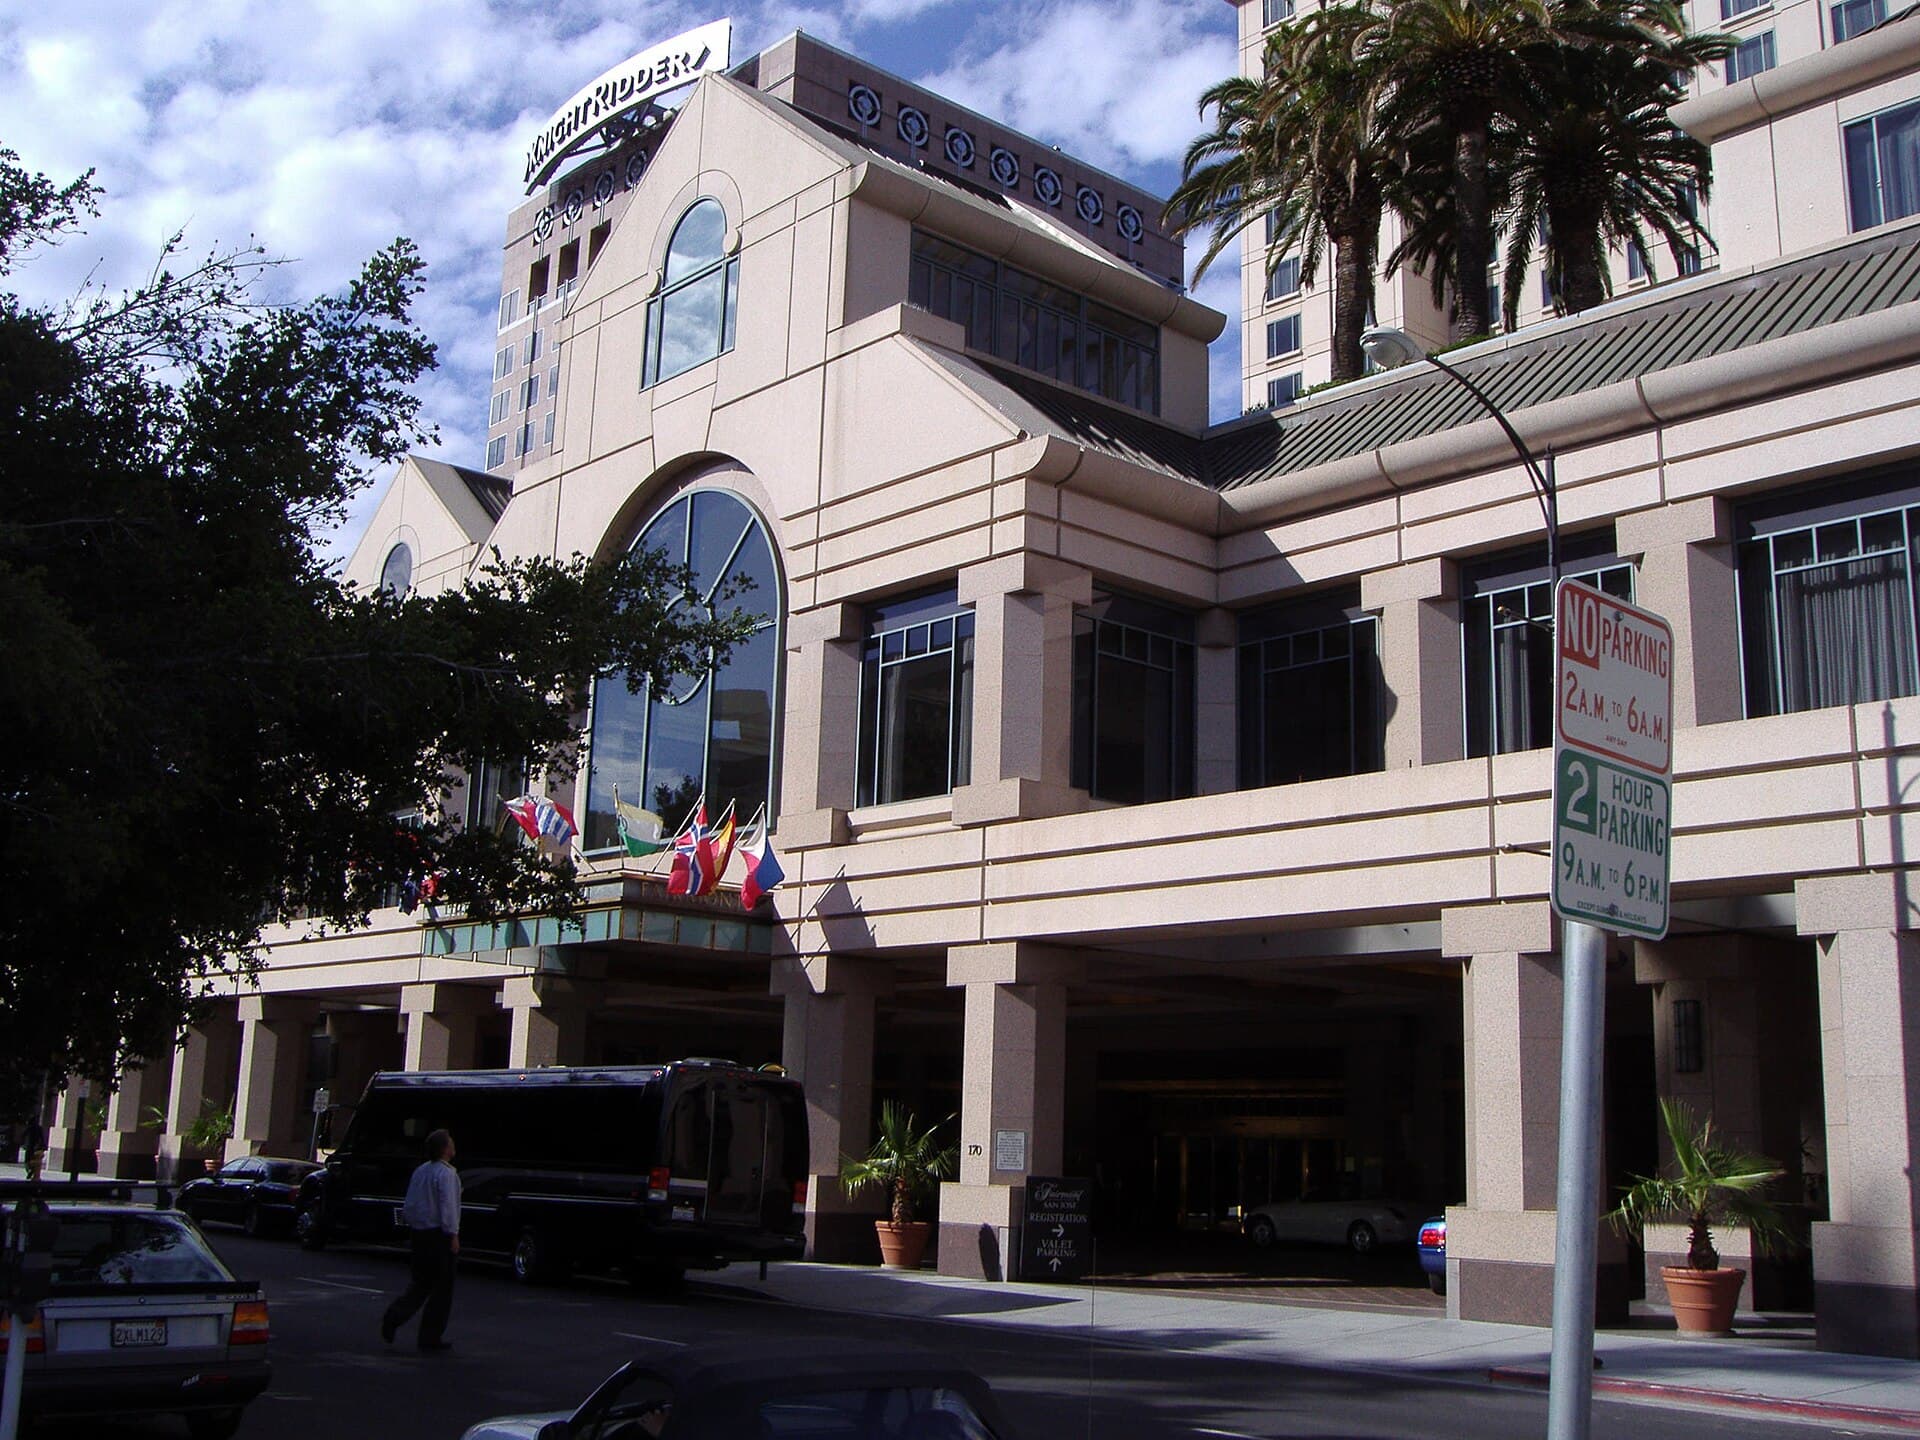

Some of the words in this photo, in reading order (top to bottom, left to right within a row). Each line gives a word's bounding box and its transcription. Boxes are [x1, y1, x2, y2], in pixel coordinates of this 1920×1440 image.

[1564, 590, 1599, 659] NO
[1602, 618, 1668, 679] PARKING
[1612, 700, 1622, 717] TO
[1566, 760, 1590, 825] 2
[1612, 774, 1654, 811] HOUR
[1599, 801, 1664, 857] PARKING
[1609, 867, 1619, 884] TO
[968, 1145, 983, 1156] 170
[1029, 1212, 1088, 1223] REGISTRATION
[1036, 1248, 1077, 1257] PARKING
[1041, 1239, 1073, 1249] VALET
[115, 1327, 164, 1344] 2XLM129
